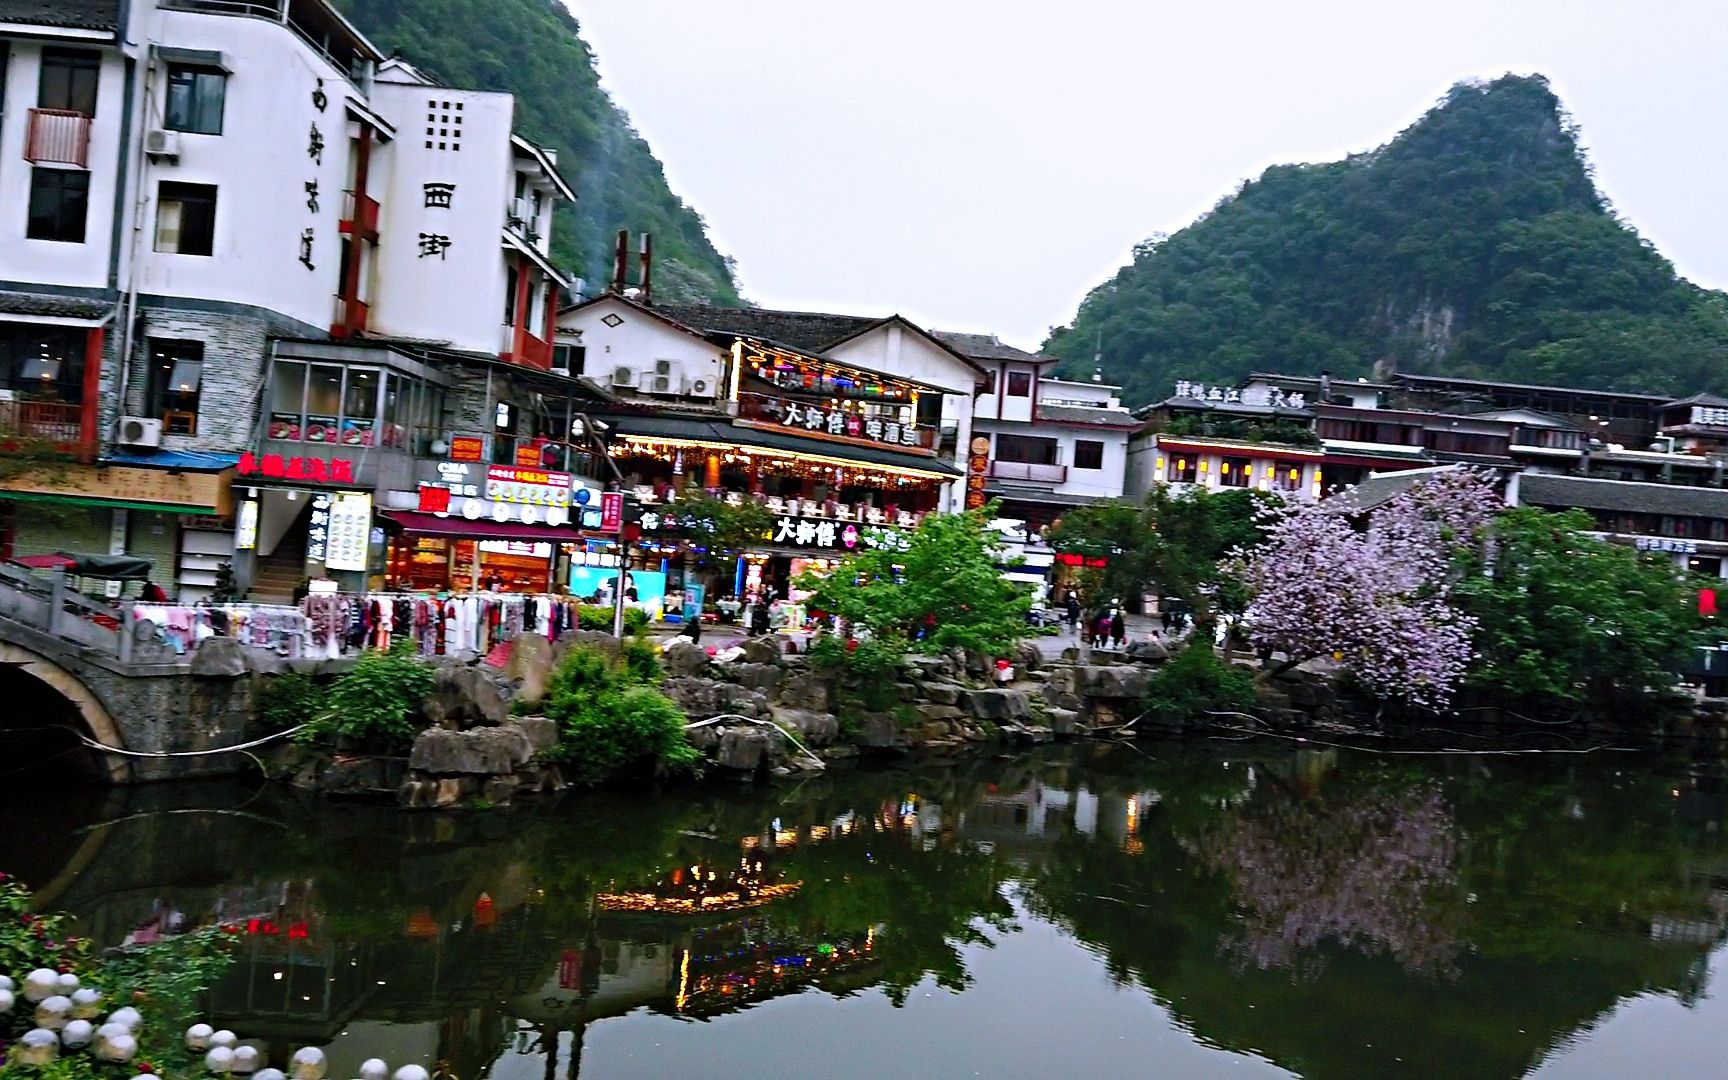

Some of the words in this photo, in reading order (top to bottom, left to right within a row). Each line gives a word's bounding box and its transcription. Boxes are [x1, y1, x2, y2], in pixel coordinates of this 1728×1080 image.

[299, 77, 328, 272] 西街味道
[418, 182, 457, 261] 西街
[773, 516, 837, 548] 大师傅
